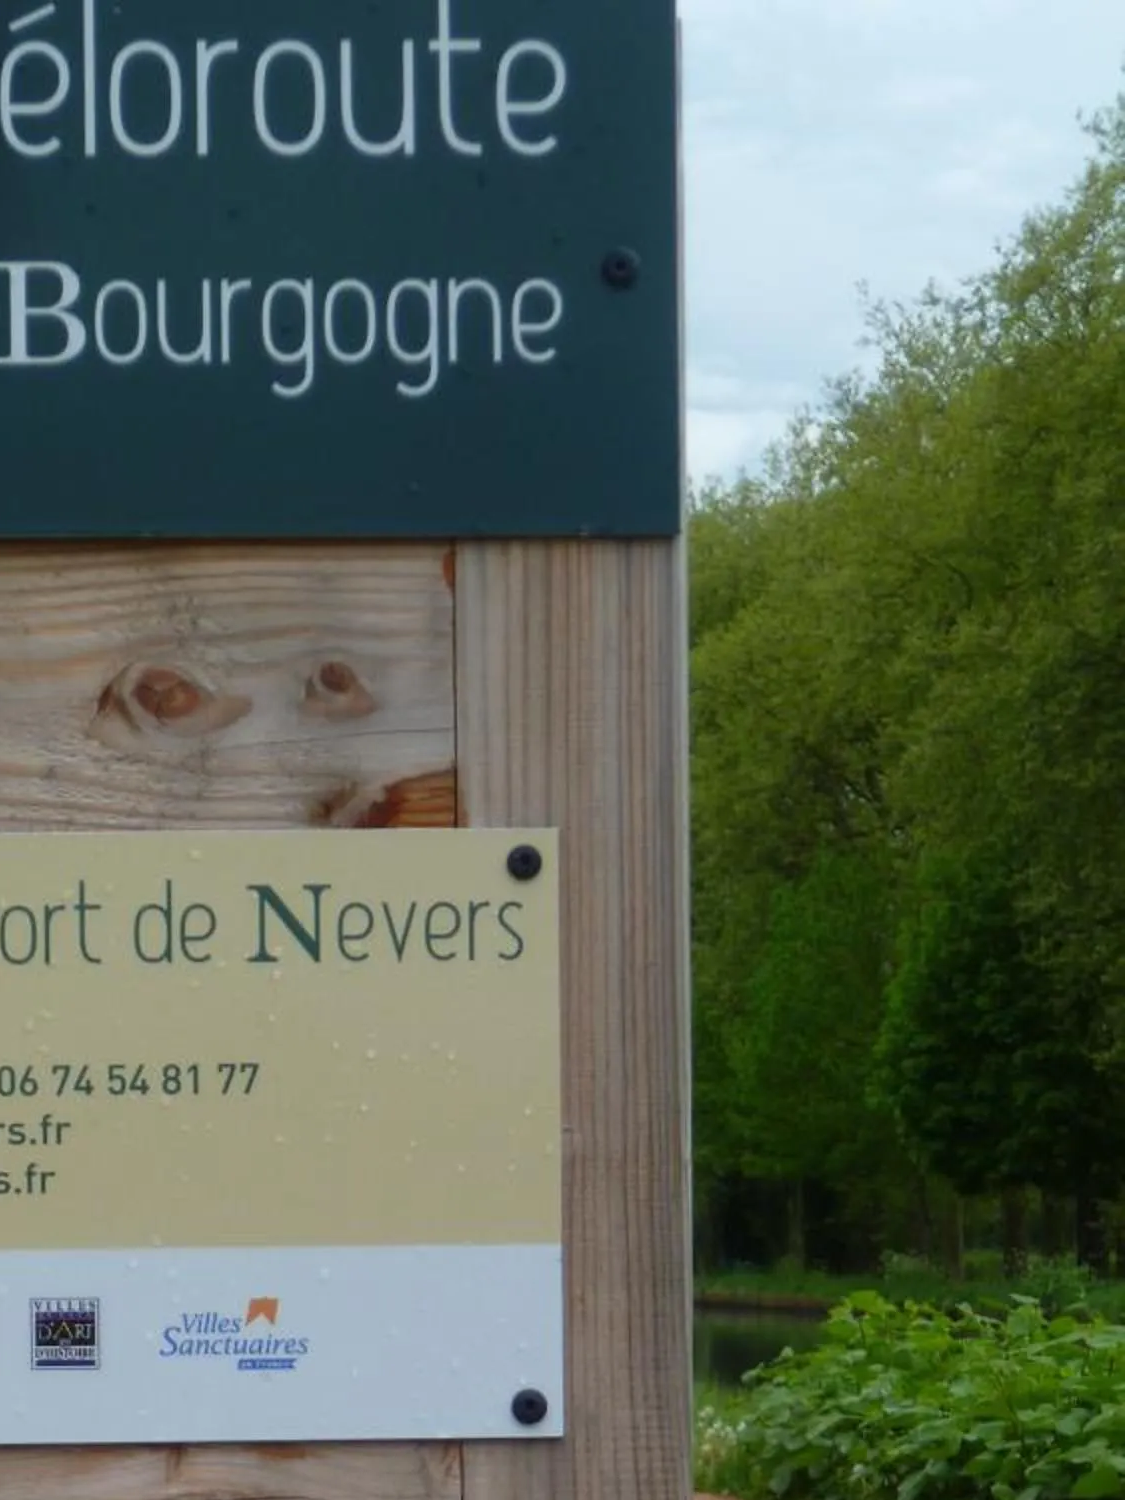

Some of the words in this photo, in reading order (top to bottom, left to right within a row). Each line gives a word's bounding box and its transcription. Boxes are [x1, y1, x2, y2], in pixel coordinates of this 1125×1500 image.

[132, 879, 218, 965] de
[246, 883, 526, 965] Nevers
[51, 1064, 94, 1096] 74
[107, 1063, 150, 1095] 54
[162, 1063, 201, 1095] 81
[217, 1062, 260, 1094] 77
[34, 1299, 96, 1312] VILLES
[180, 1311, 242, 1335] Villes
[158, 1326, 310, 1357] Sanctuaires
